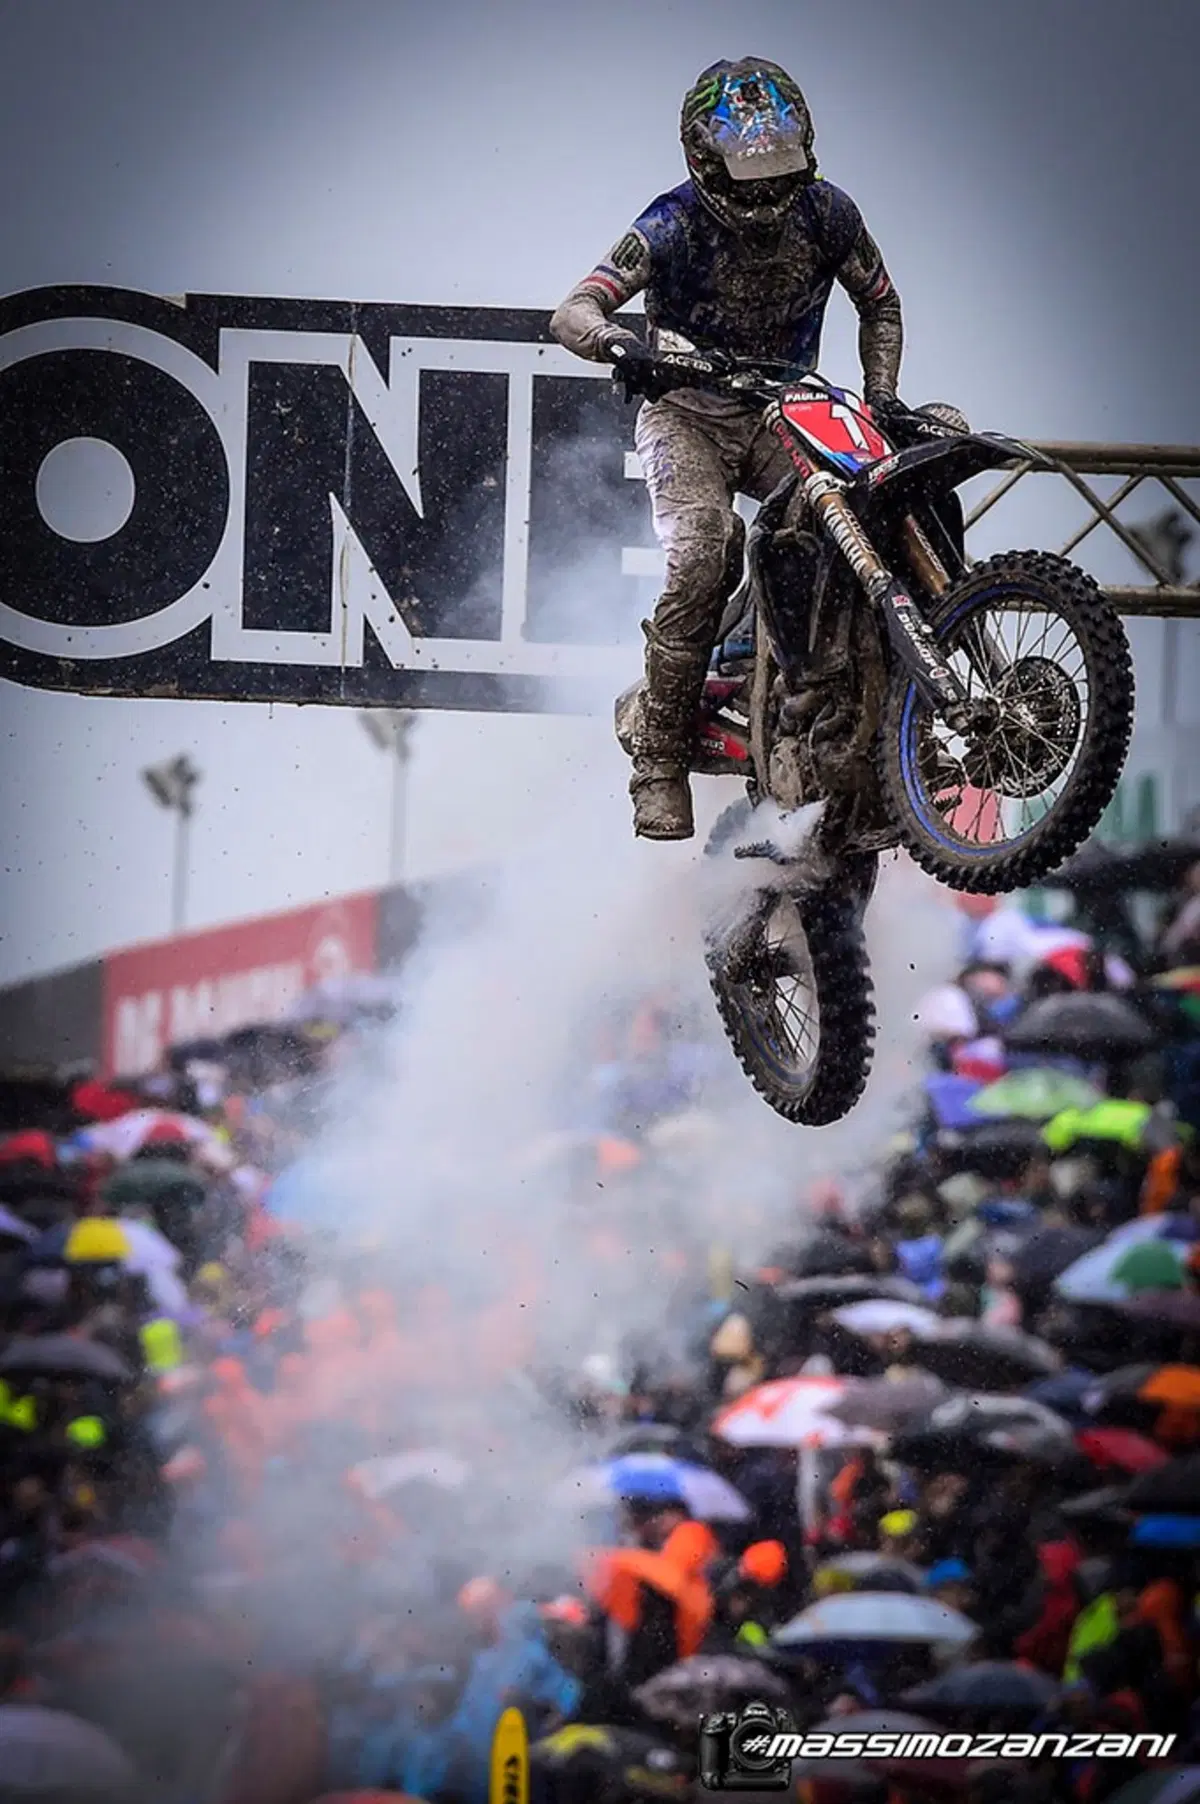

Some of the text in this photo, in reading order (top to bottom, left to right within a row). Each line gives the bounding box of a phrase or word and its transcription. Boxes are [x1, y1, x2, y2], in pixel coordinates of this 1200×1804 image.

[784, 391, 829, 402] PAULIN
[831, 403, 871, 452] 1
[897, 612, 938, 668] DUNLOP
